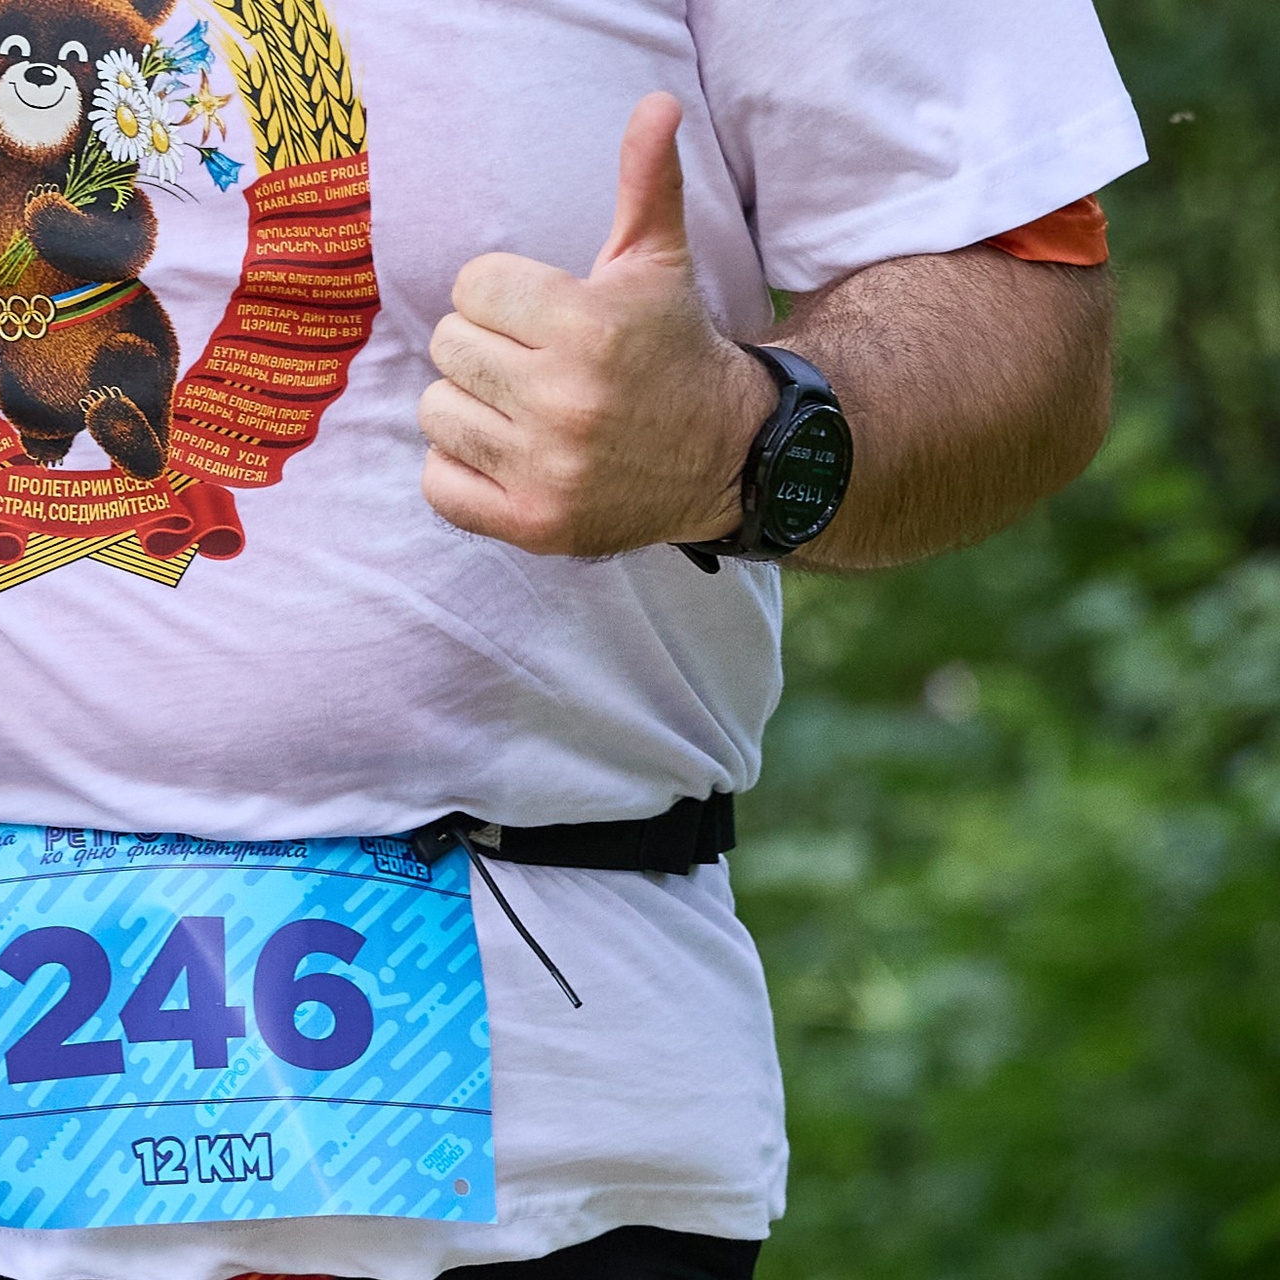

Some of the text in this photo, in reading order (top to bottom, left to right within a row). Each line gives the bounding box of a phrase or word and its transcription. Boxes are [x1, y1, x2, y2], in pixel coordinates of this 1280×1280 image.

[288, 170, 328, 189] MAADE
[256, 190, 322, 213] TAARLASED,
[7, 475, 113, 498] ПРОЛЕТАРИИ
[48, 492, 171, 525] СОЕДИНЯЙТЕСЬ!
[40, 841, 308, 868] ко дню физкультурника
[376, 854, 429, 881] СОЮЗ
[132, 1135, 189, 1186] 12
